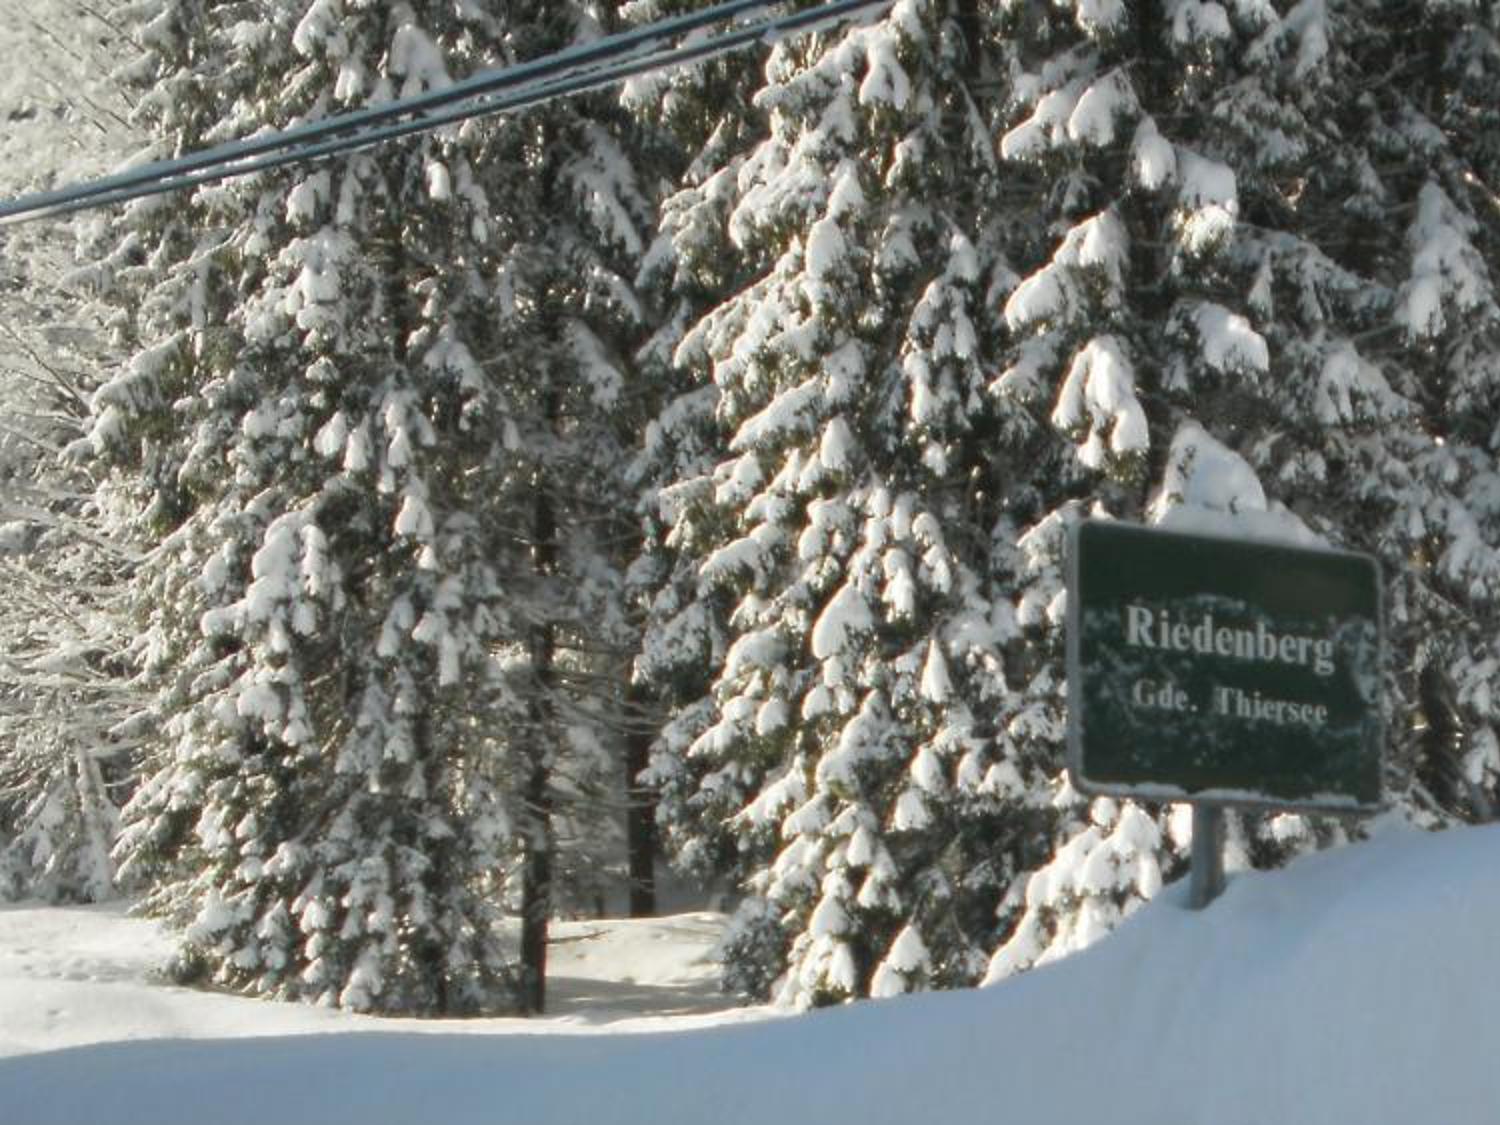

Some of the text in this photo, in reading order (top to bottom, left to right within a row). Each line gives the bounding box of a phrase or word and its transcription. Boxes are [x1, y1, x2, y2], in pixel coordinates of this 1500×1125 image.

[1126, 605, 1335, 675] Riedenberg
[1133, 679, 1328, 724] Gde. Thiersee
